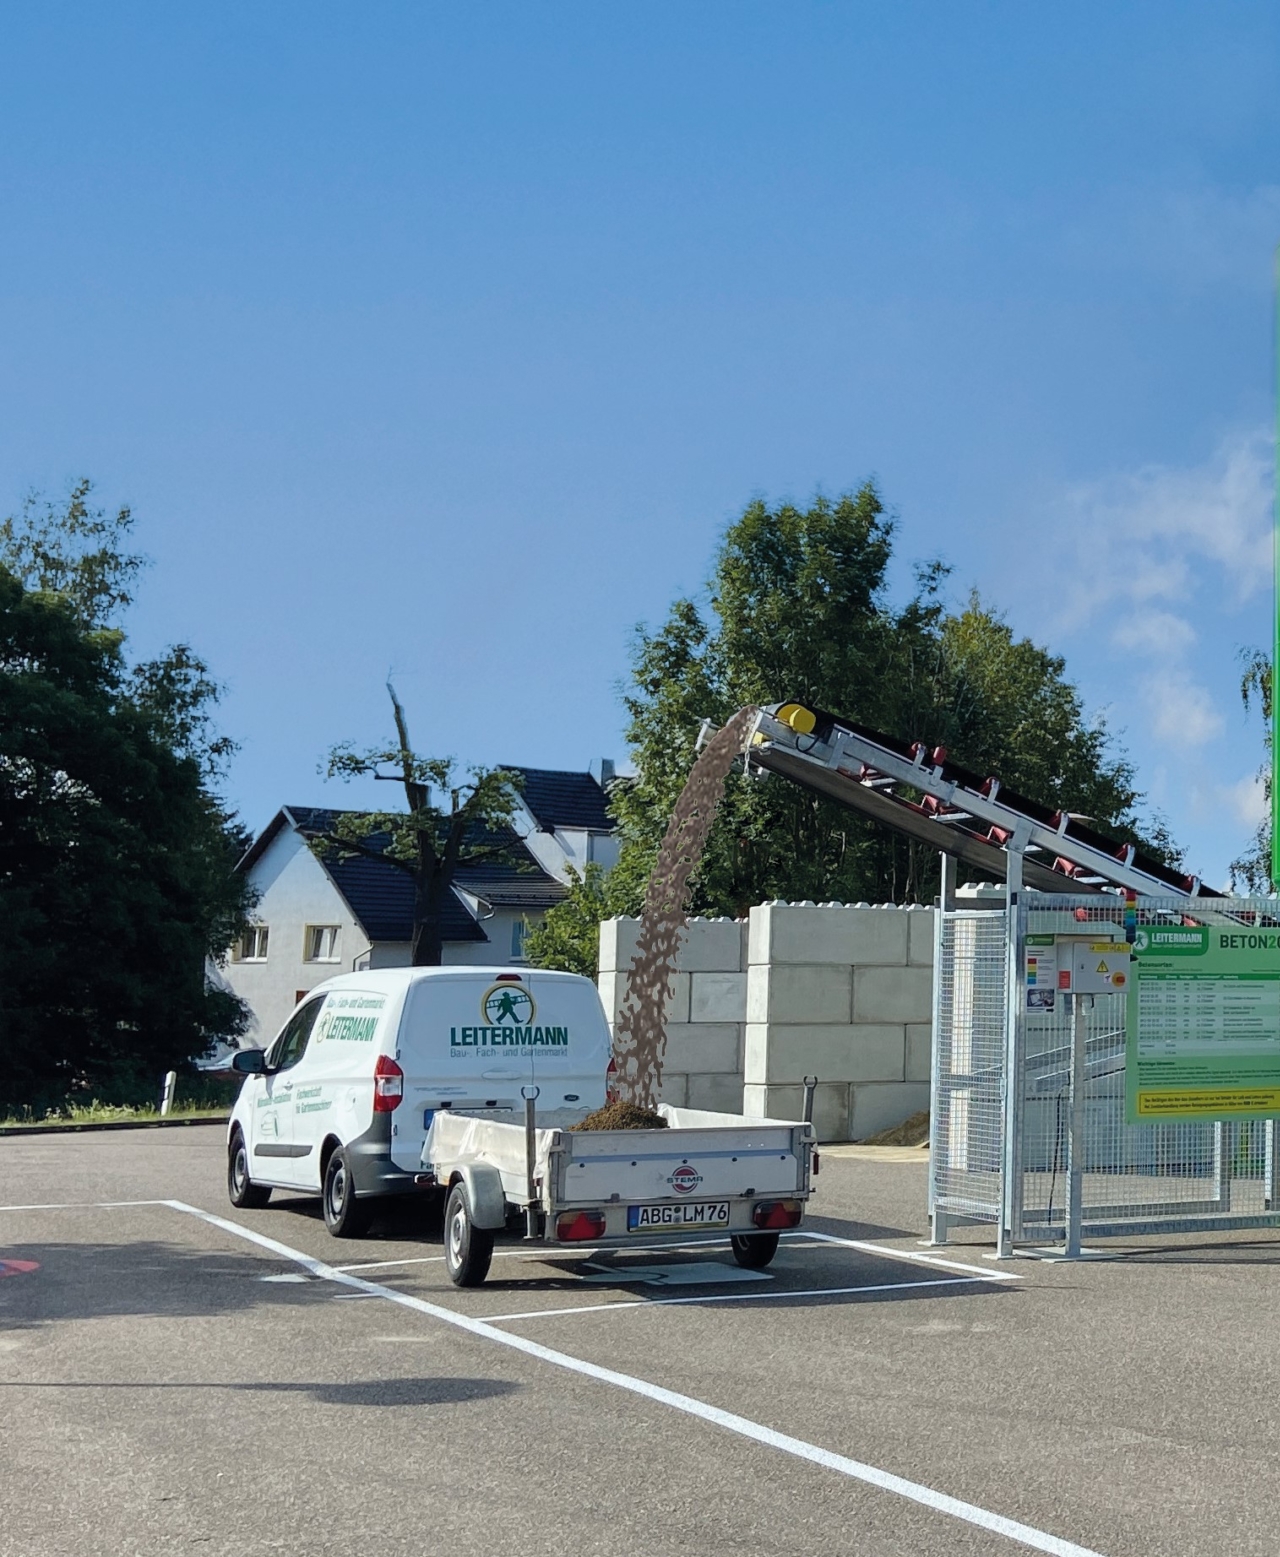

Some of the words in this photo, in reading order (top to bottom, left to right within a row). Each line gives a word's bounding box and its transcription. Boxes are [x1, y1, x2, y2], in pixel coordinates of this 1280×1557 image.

[1151, 933, 1202, 943] LEITERMANN
[326, 1016, 379, 1042] LEITERMANN
[450, 1026, 568, 1046] LEITERMANN
[476, 1048, 499, 1057] Fach-
[503, 1048, 518, 1057] und
[521, 1047, 568, 1057] Gartenmarkt
[667, 1175, 703, 1184] STEMA
[640, 1207, 672, 1225] ABG
